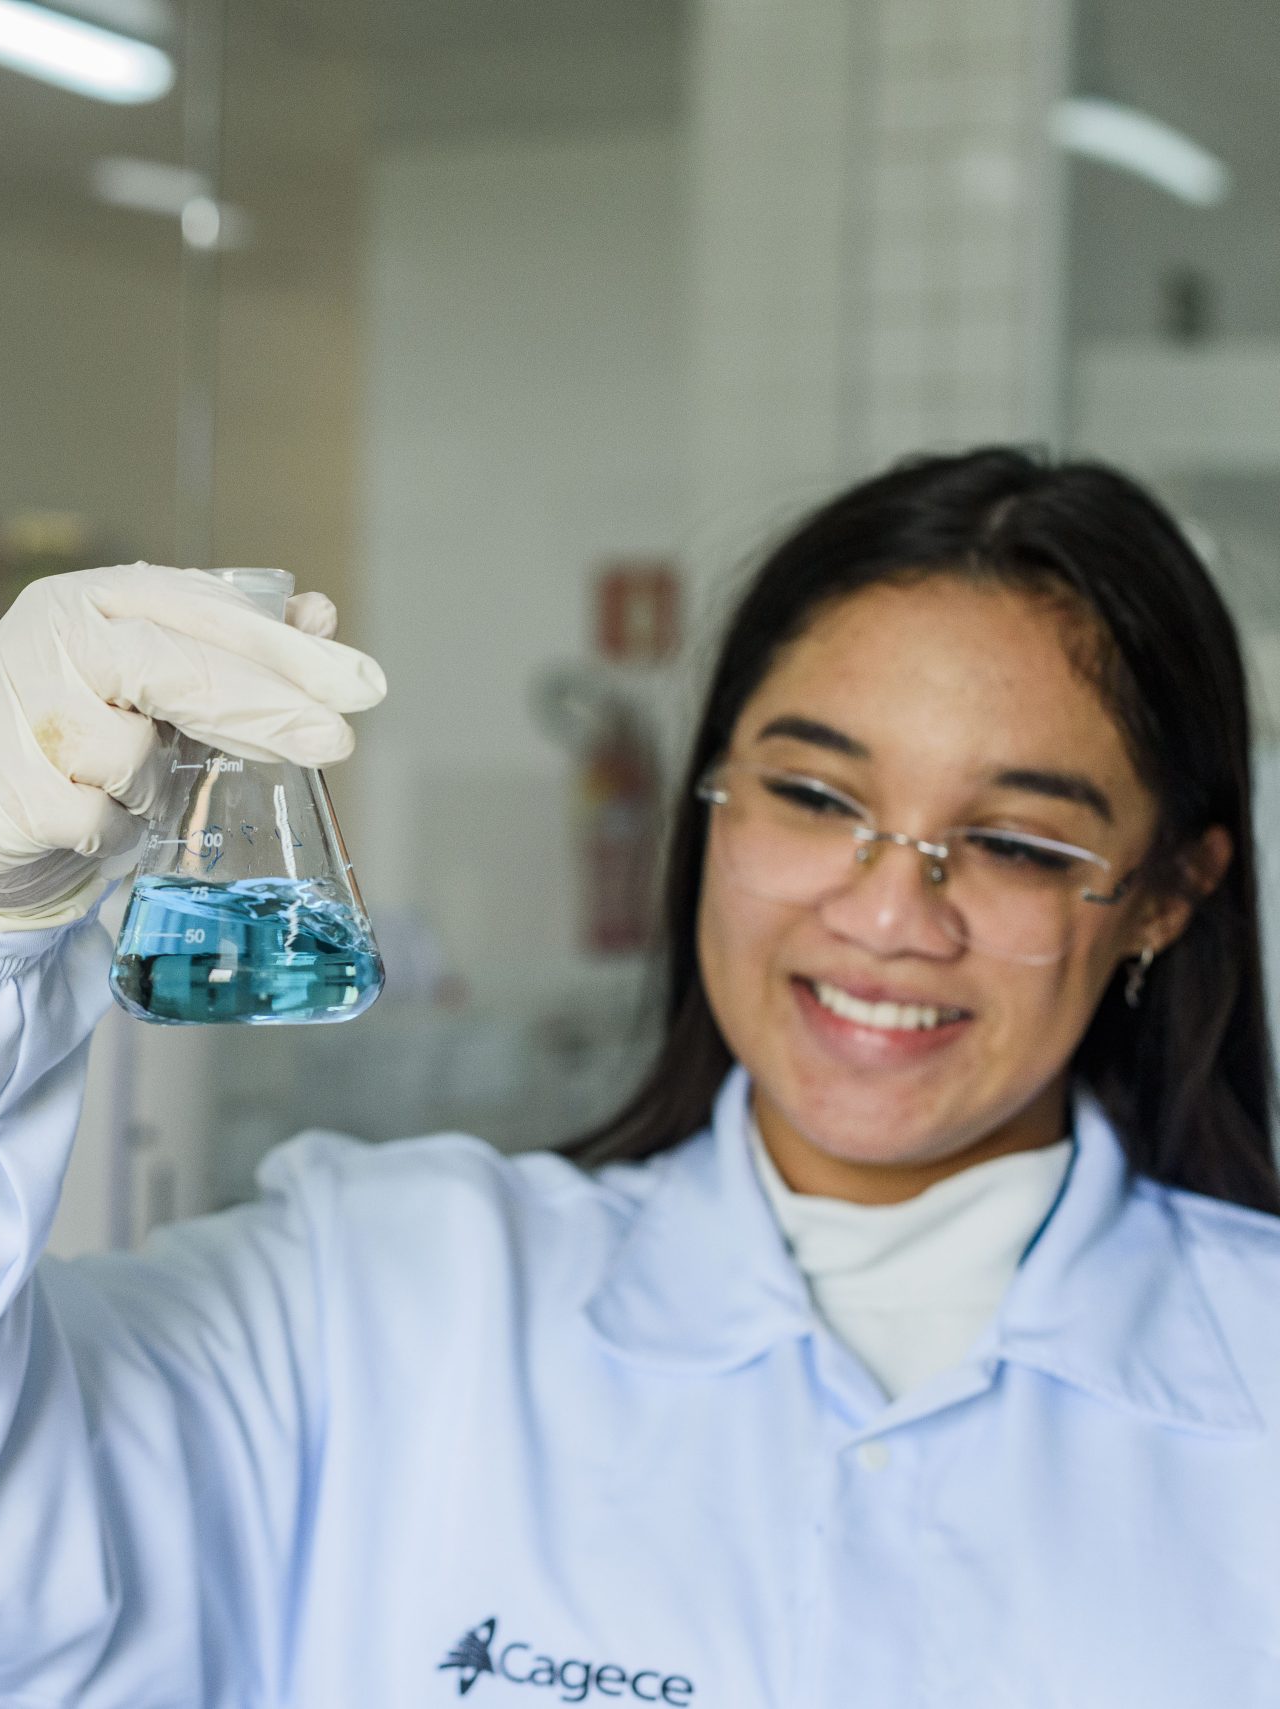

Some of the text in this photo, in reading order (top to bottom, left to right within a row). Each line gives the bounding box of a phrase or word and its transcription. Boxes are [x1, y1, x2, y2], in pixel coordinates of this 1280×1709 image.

[190, 886, 210, 900] 75
[184, 928, 206, 944] 50
[499, 1642, 694, 1708] Cagece
